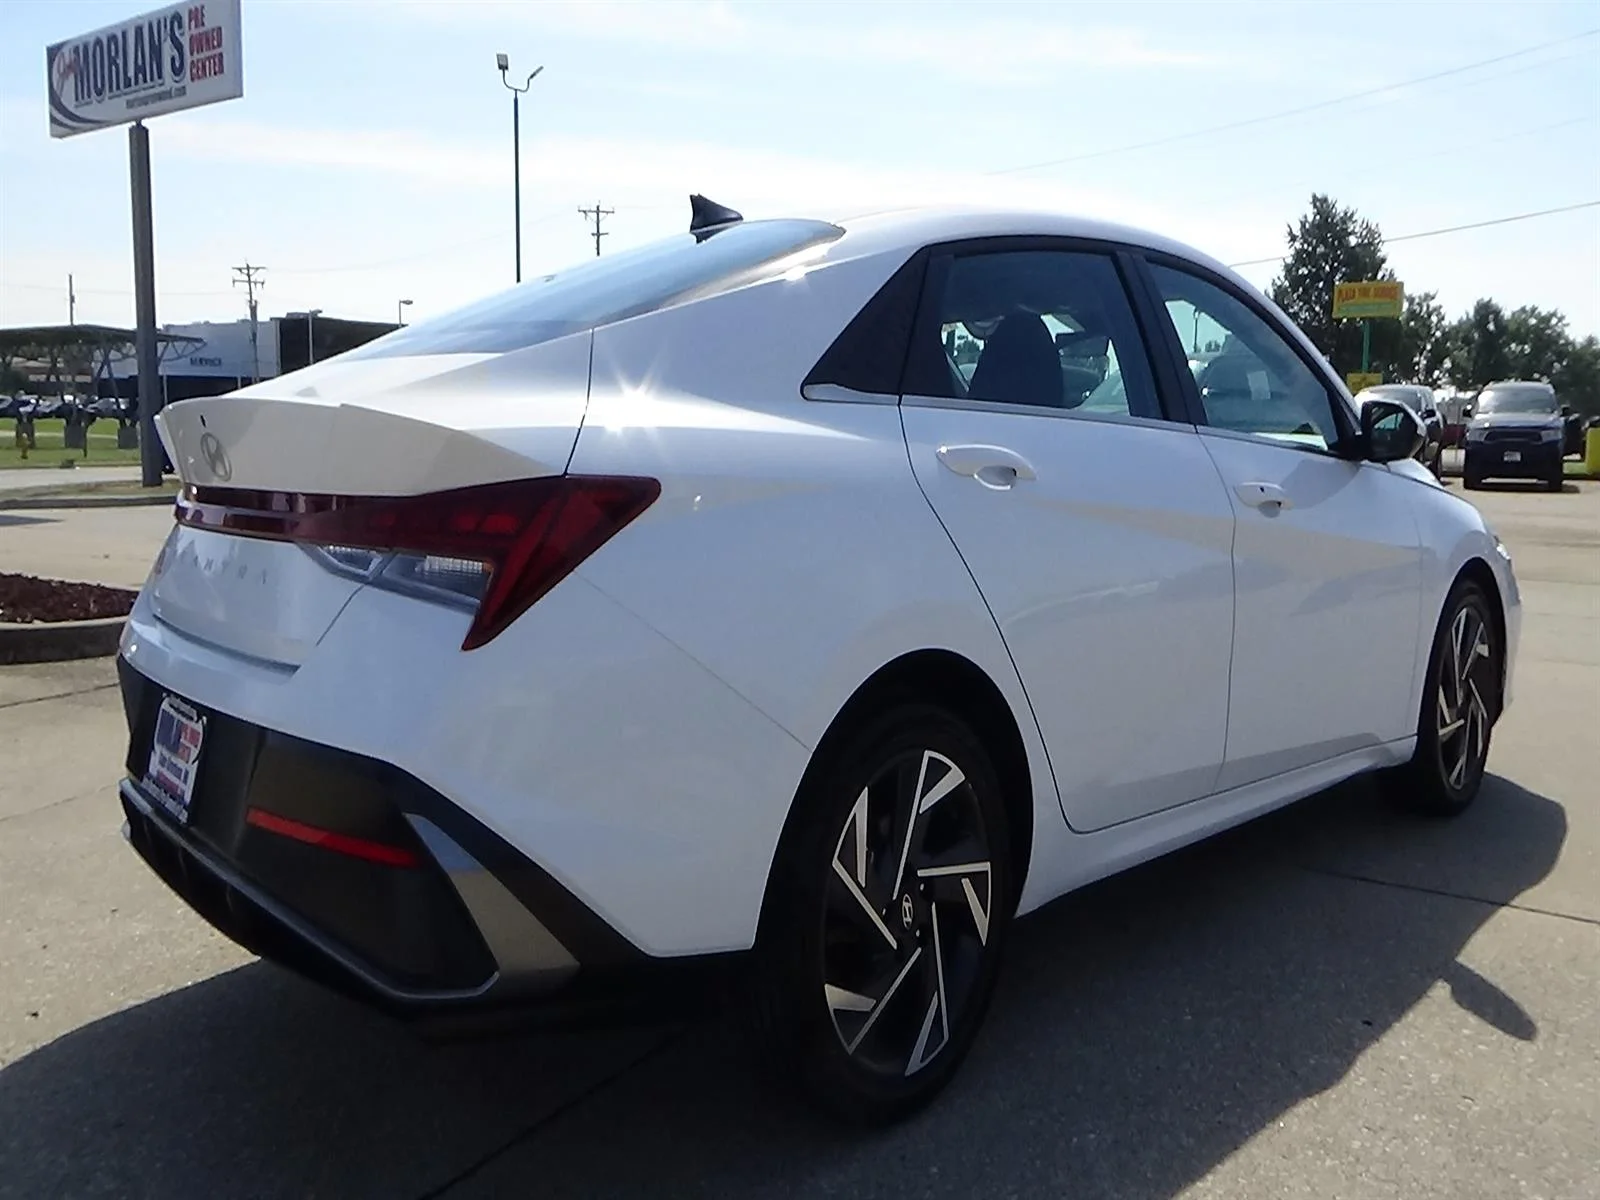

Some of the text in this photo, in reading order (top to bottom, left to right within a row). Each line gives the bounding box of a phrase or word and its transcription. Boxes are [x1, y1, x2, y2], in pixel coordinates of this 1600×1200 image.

[188, 5, 205, 31] PRE
[73, 11, 185, 102] MORLAN'S
[188, 26, 223, 57] OWNED
[189, 52, 225, 83] CENTER
